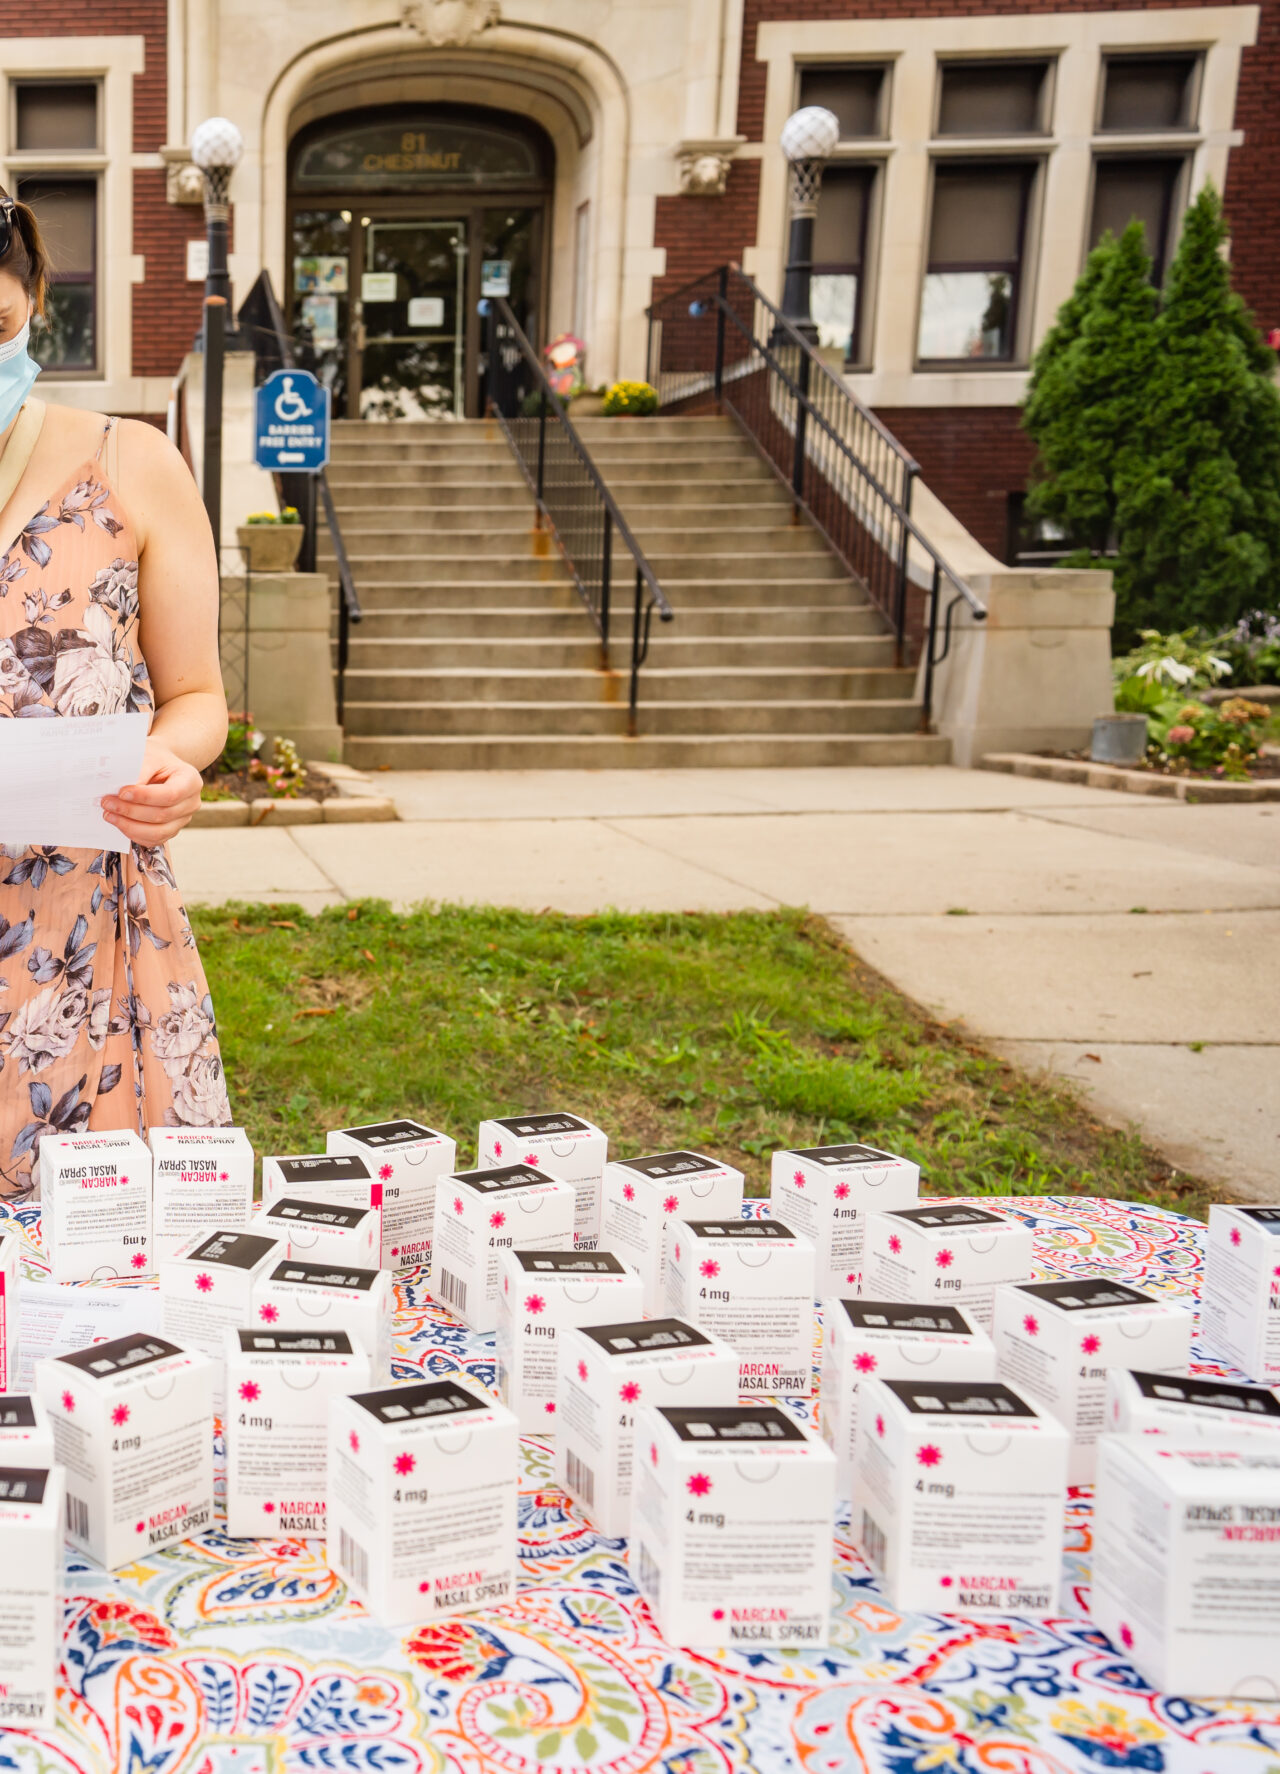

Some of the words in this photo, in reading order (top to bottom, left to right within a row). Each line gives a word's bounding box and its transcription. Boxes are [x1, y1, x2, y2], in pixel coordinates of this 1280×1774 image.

[402, 132, 426, 152] 81
[363, 152, 461, 171] CHESTNUT
[268, 424, 314, 435] BARRIER
[259, 436, 285, 447] FREE
[287, 436, 322, 448] ENTRY
[89, 1165, 117, 1176] NASAL
[158, 1159, 186, 1171] SPRAY
[189, 1159, 217, 1170] NASAL
[59, 1166, 87, 1178] SPRAY
[181, 1171, 217, 1182] NARCAN
[81, 1176, 117, 1189] NARCAN
[385, 1187, 400, 1198] mg
[833, 1208, 840, 1219] 4
[841, 1208, 857, 1220] mg
[123, 1235, 139, 1246] mg
[141, 1236, 147, 1246] 4
[401, 1240, 431, 1255] NARCAN
[489, 1237, 495, 1248] 4
[496, 1237, 513, 1248] mg
[573, 1240, 599, 1250] SPRAY
[400, 1252, 424, 1266] NASAL
[934, 1278, 941, 1289] 4
[943, 1279, 962, 1291] mg
[699, 1288, 707, 1299] 4
[709, 1290, 730, 1303] mg
[524, 1323, 531, 1335] 4
[535, 1327, 555, 1339] mg
[1079, 1366, 1087, 1378] 4
[772, 1377, 806, 1389] SPRAY
[238, 1413, 246, 1427] 4
[250, 1416, 272, 1430] mg
[113, 1440, 119, 1451] 4
[122, 1436, 141, 1450] mg
[915, 1480, 923, 1492] 4
[928, 1483, 954, 1498] mg
[394, 1490, 401, 1503] 4
[405, 1489, 428, 1504] mg
[280, 1502, 327, 1515] NARCAN
[149, 1504, 188, 1529] NARCAN
[280, 1517, 319, 1530] NASAL
[686, 1510, 694, 1524] 4
[699, 1512, 724, 1528] mg
[149, 1524, 179, 1545] NASAL
[181, 1509, 210, 1532] SPRAY
[435, 1571, 482, 1591] NARCAN
[960, 1576, 1017, 1591] NARCAN
[435, 1591, 470, 1609] NASAL
[475, 1582, 511, 1600] SPRAY
[959, 1594, 1001, 1609] NASAL
[1008, 1594, 1050, 1610] SPRAY
[731, 1608, 788, 1622] NARCAN
[730, 1626, 773, 1640] NASAL
[779, 1626, 821, 1640] SPRAY
[0, 1702, 45, 1718] SPRAY
